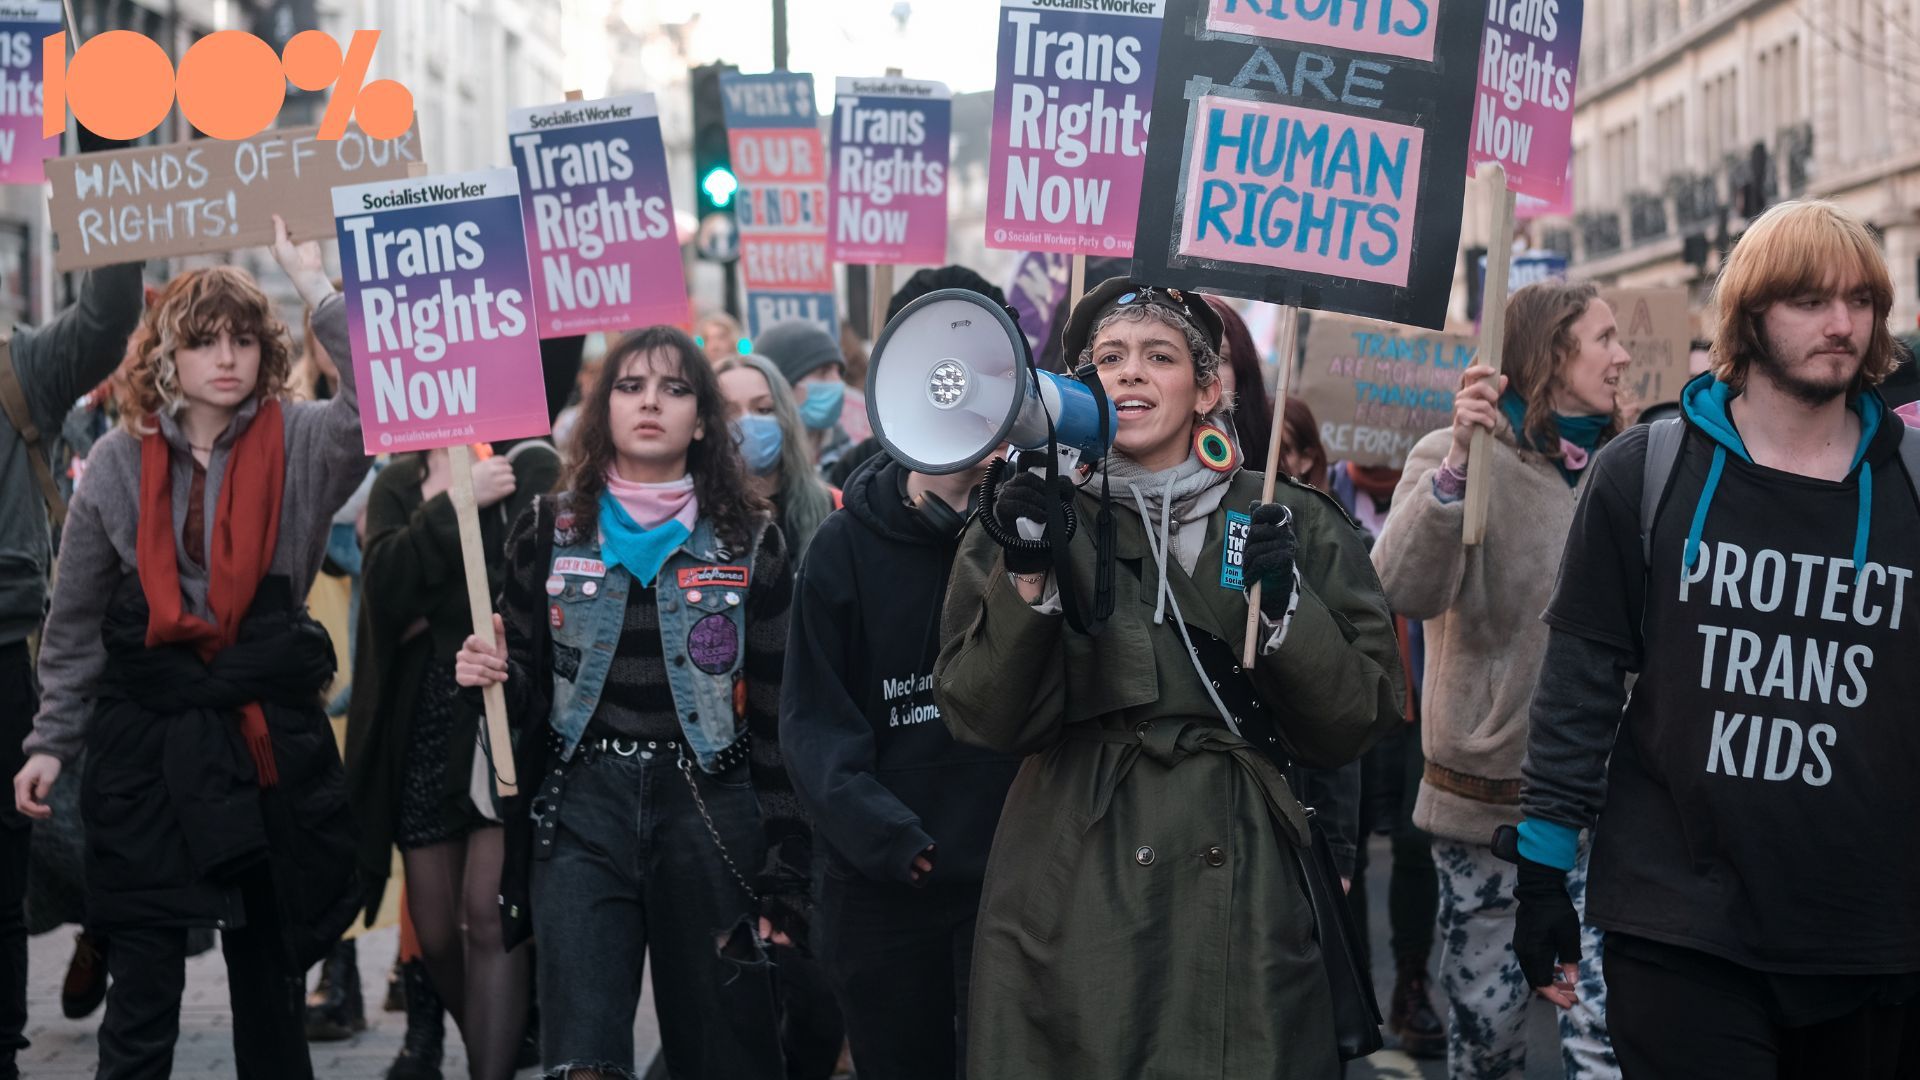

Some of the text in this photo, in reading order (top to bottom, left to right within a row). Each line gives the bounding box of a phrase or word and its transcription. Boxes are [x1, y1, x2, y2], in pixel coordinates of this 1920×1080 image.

[1099, 0, 1156, 14] Worker
[1008, 10, 1142, 84] Trans
[1230, 46, 1393, 109] ARE
[1482, 26, 1571, 112] Rights
[837, 97, 925, 145] Trans
[1475, 92, 1533, 167] Now
[75, 149, 208, 200] HANDS
[234, 136, 318, 186] OFF
[514, 133, 634, 190] Trans
[737, 136, 812, 176] OUR
[838, 146, 944, 205] Rights
[1203, 109, 1410, 201] HUMAN
[78, 190, 238, 254] RIGHTS!
[738, 188, 826, 225] GENDER
[837, 196, 909, 244] Now
[1004, 155, 1111, 226] Now
[343, 216, 484, 282] Trans
[532, 187, 669, 260] Rights
[1008, 231, 1099, 249] Socialist Workers Party
[1196, 179, 1400, 267] RIGHTS
[542, 253, 631, 312] Now
[744, 241, 827, 283] REFORM
[361, 278, 526, 362] Rights
[1352, 332, 1430, 364] TRANS
[369, 357, 476, 424] Now
[393, 424, 475, 444] socialistworker.co.uk
[698, 567, 743, 581] deftones
[1226, 568, 1239, 577] Join
[1679, 538, 1913, 630] PROTECT
[1698, 624, 1874, 708] TRANS
[890, 706, 899, 727] &
[1706, 710, 1837, 787] KIDS
